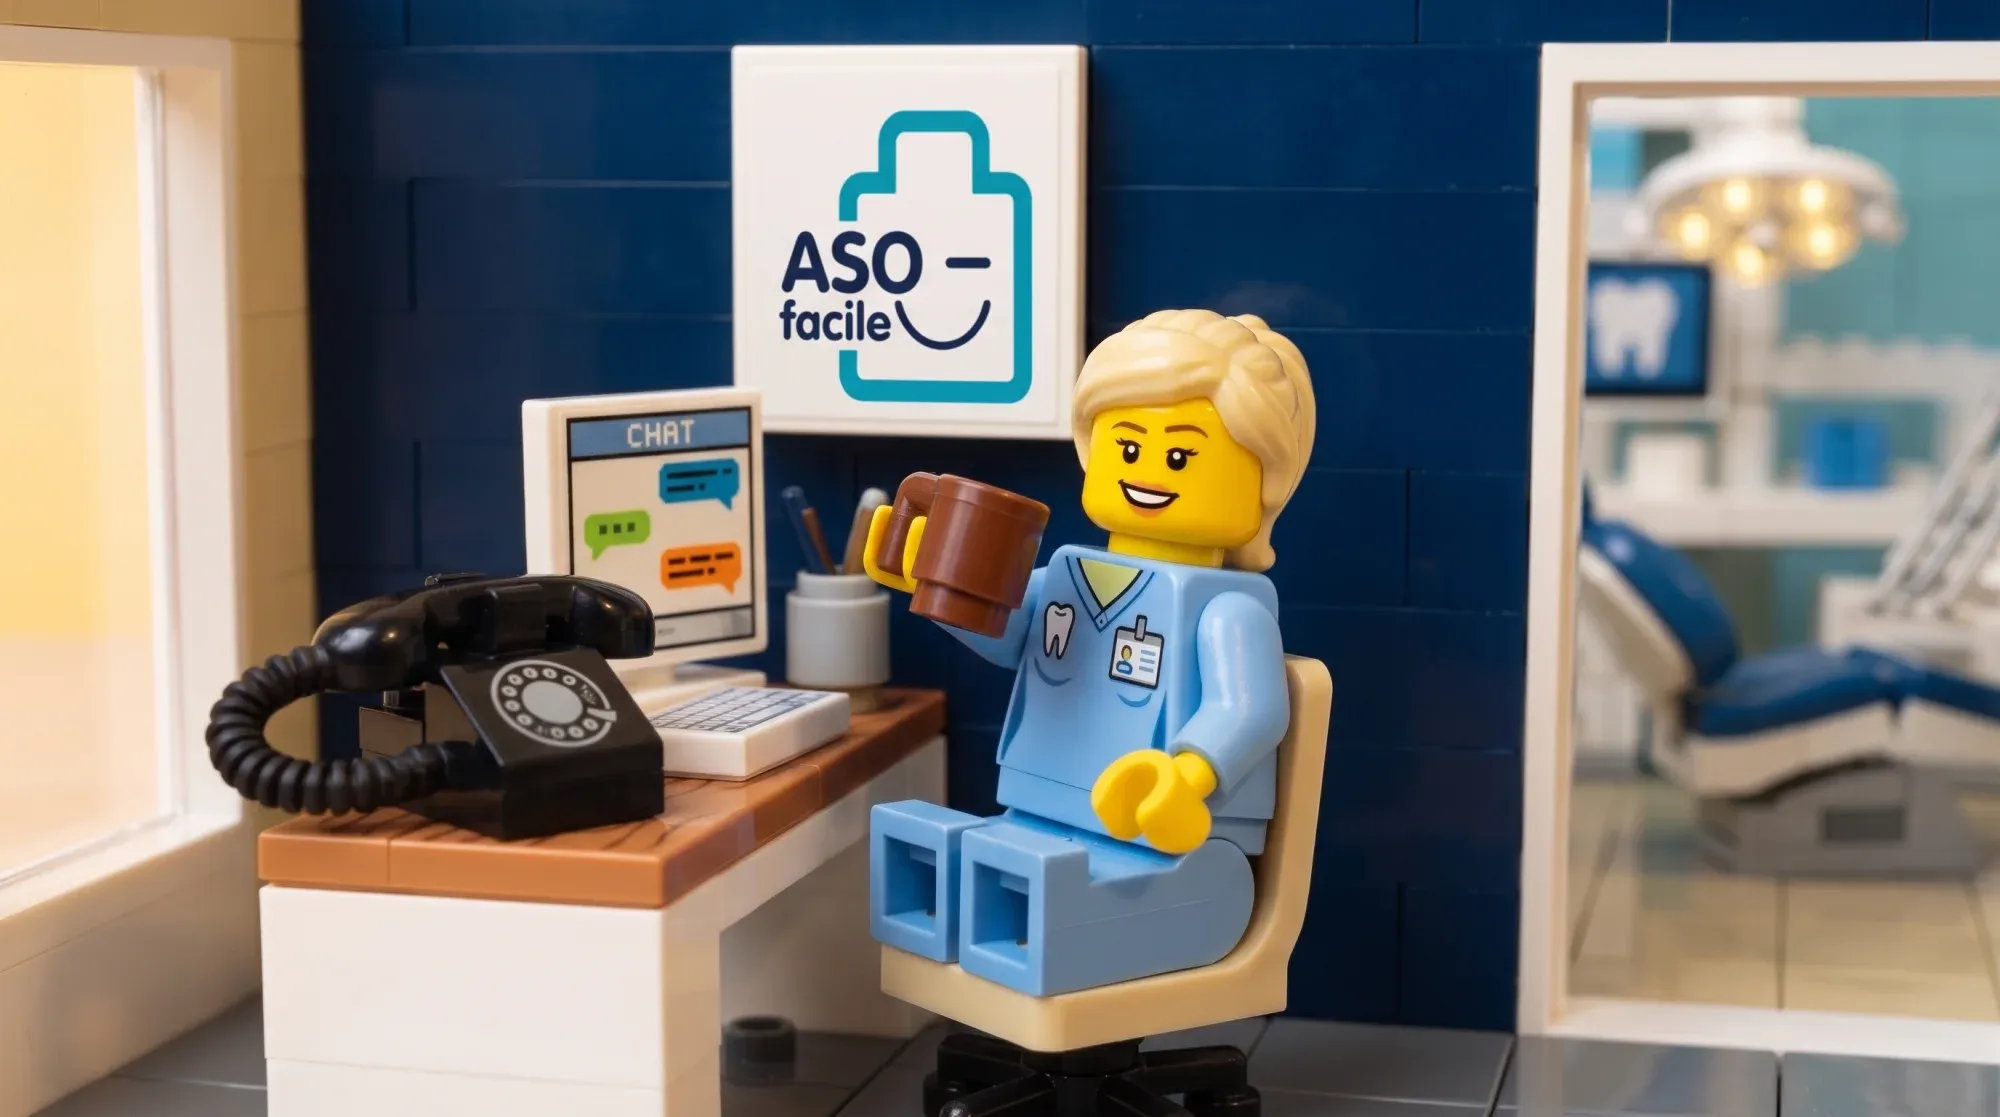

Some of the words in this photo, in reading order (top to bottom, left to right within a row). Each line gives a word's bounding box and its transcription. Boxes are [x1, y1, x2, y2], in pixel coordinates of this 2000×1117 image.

[781, 230, 923, 295] ASO
[779, 298, 892, 342] facile
[626, 419, 696, 448] CHAT
